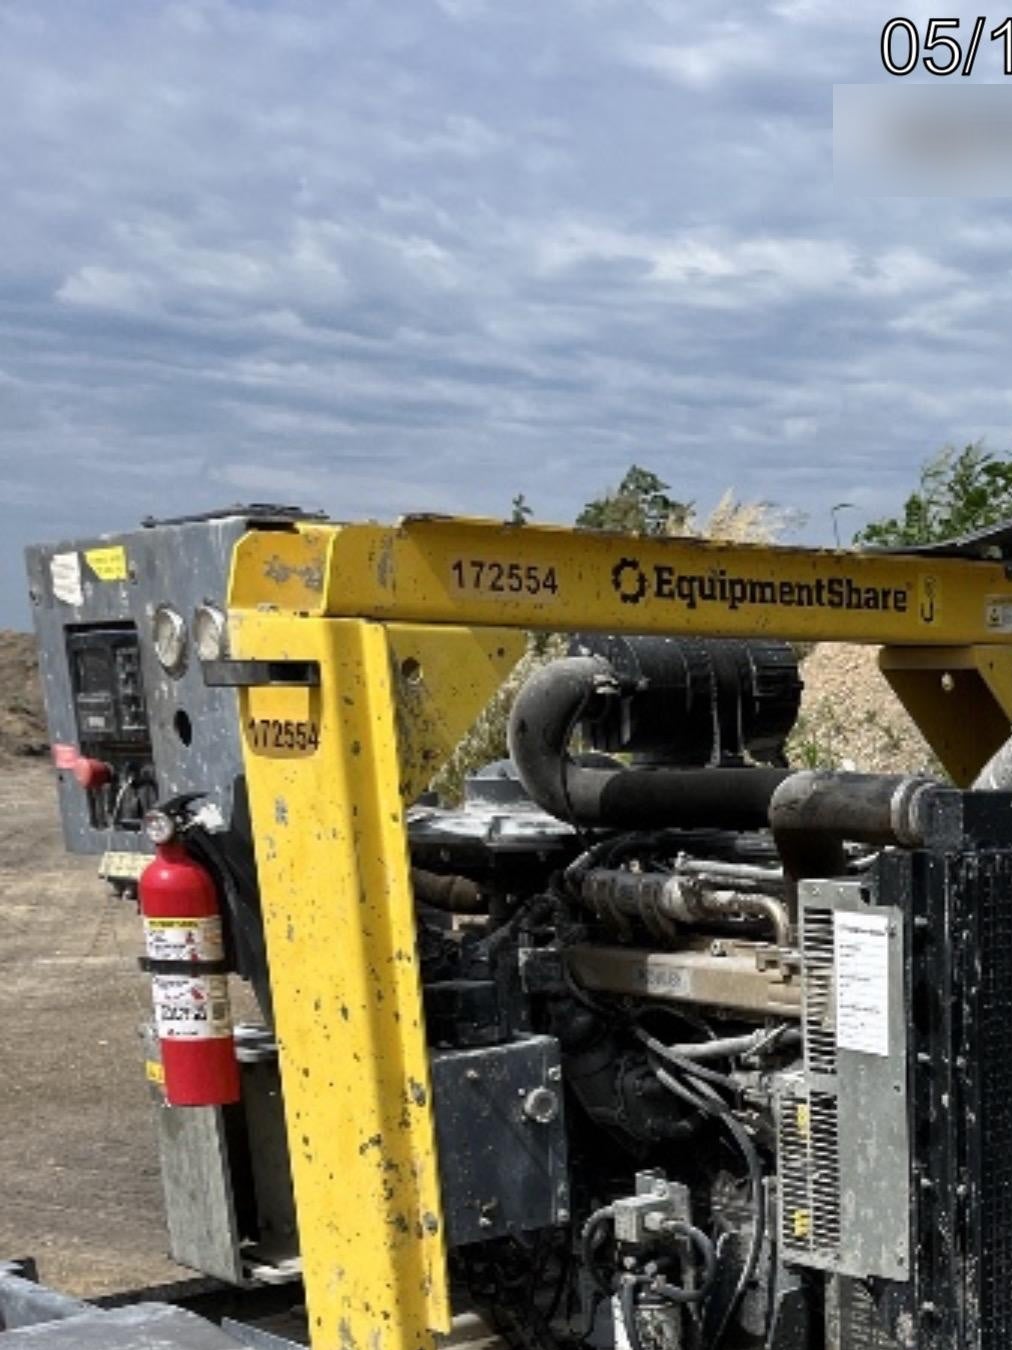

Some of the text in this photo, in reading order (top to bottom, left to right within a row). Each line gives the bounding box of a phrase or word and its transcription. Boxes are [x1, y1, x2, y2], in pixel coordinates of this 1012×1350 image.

[451, 560, 559, 595] 172554
[653, 565, 908, 613] EquipmentShare
[248, 717, 319, 750] 172554
